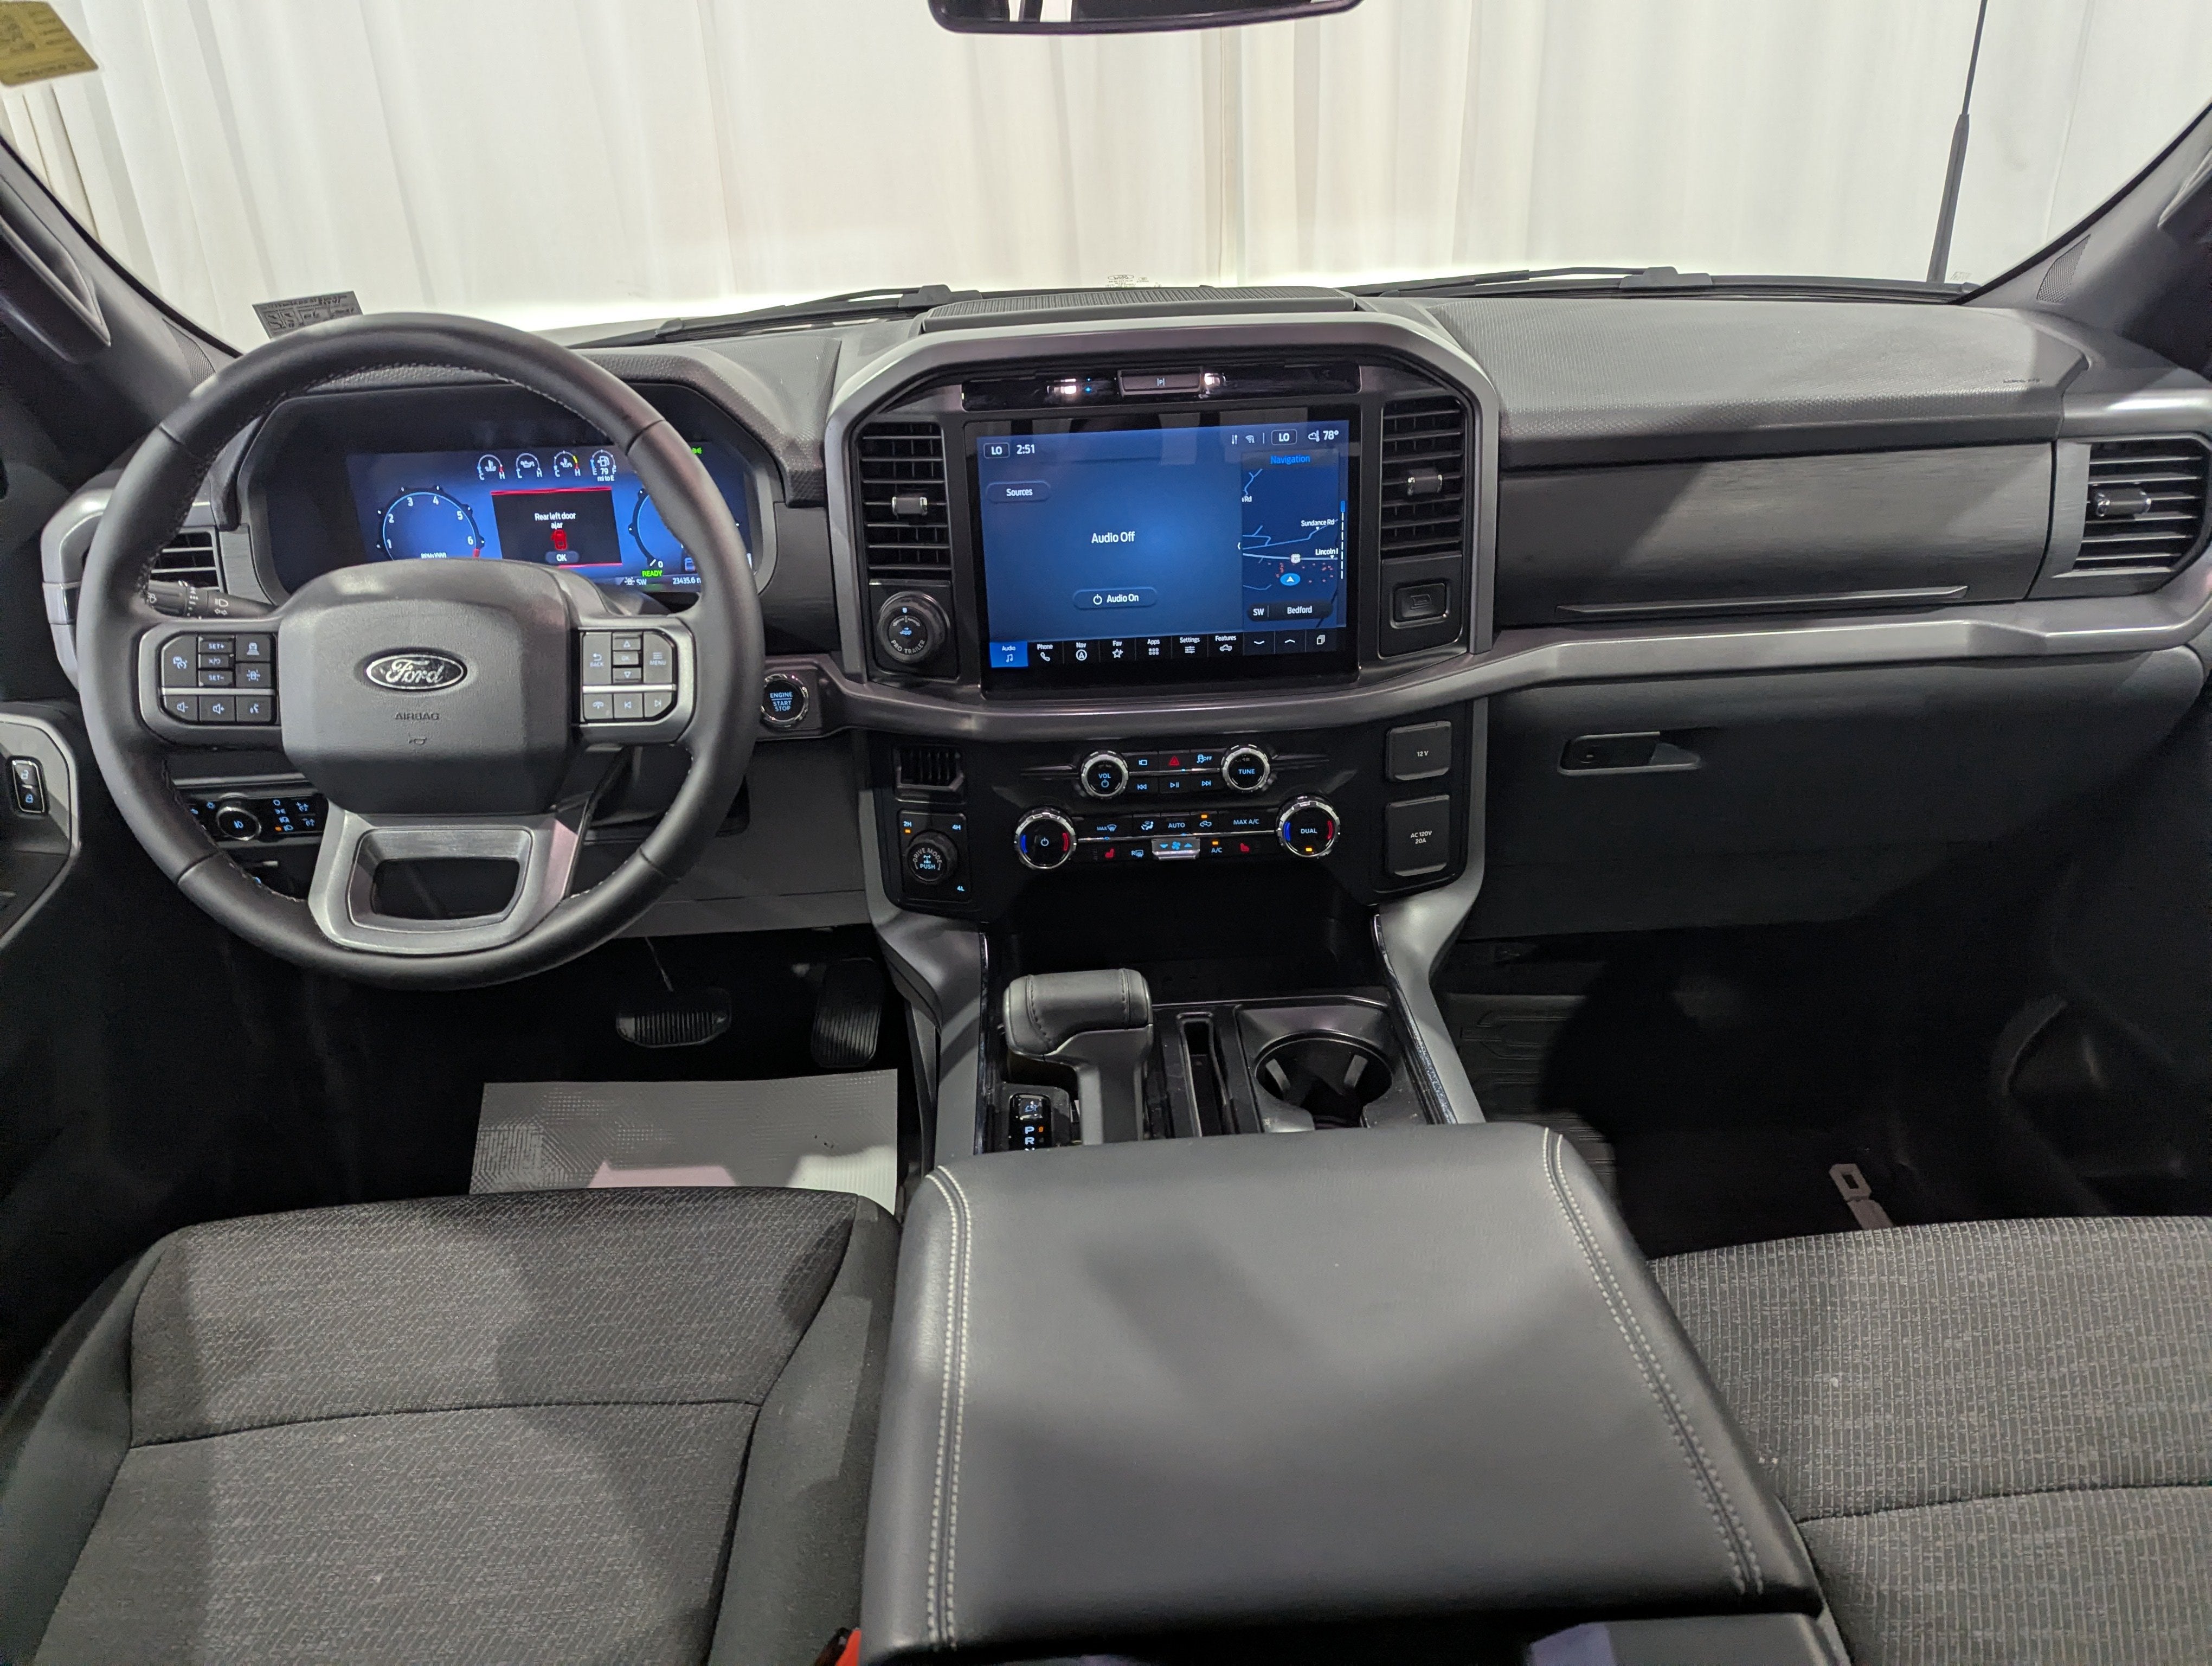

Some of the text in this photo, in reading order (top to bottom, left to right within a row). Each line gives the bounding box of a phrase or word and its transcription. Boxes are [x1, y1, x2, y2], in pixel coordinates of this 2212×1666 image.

[1278, 433, 1290, 442] LO
[1323, 430, 1339, 440] 78°
[991, 446, 1002, 455] LO
[1017, 444, 1035, 454] 2:51
[1270, 455, 1310, 465] Navigation
[574, 469, 581, 477] H
[1006, 488, 1033, 497] Sources
[407, 497, 413, 507] 3
[433, 496, 439, 505] 4
[388, 514, 394, 523] 2
[457, 510, 463, 520] 5
[549, 512, 561, 520] left
[561, 511, 576, 520] door
[551, 521, 563, 530] ajar
[467, 536, 473, 545] 6
[1091, 531, 1135, 543] Audio Off
[387, 539, 392, 549] 1
[672, 576, 696, 585] 23435.6
[1107, 593, 1139, 603] Audio On
[1287, 606, 1313, 614] Bedford
[891, 640, 925, 653] PRO TRAILER
[385, 658, 445, 683] Ford
[395, 712, 440, 721] AIRBAG
[912, 848, 942, 863] DRIVE MODE
[1025, 1137, 1035, 1145] R
